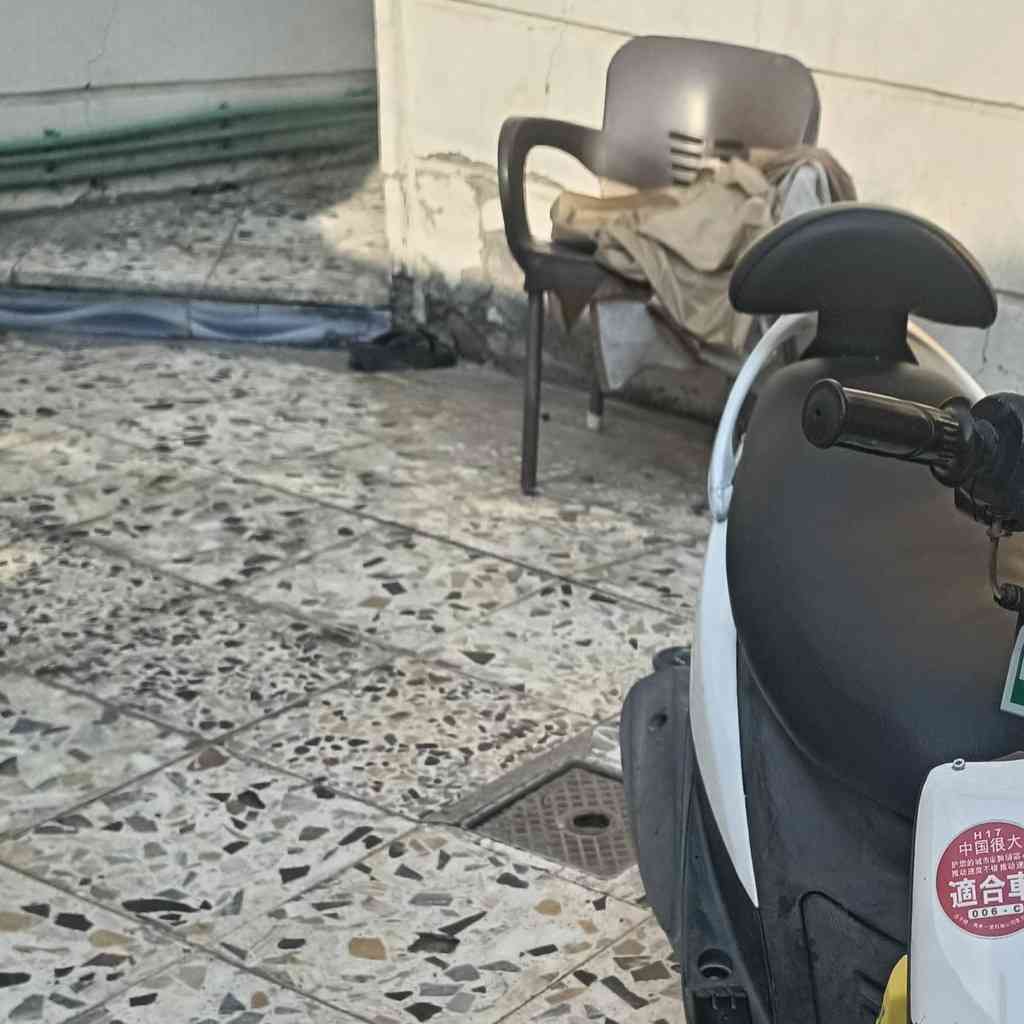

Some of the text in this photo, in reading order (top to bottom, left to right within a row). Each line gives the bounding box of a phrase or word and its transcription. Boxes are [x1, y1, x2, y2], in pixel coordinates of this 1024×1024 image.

[974, 828, 1002, 840] H17
[959, 834, 1023, 856] 中国很大
